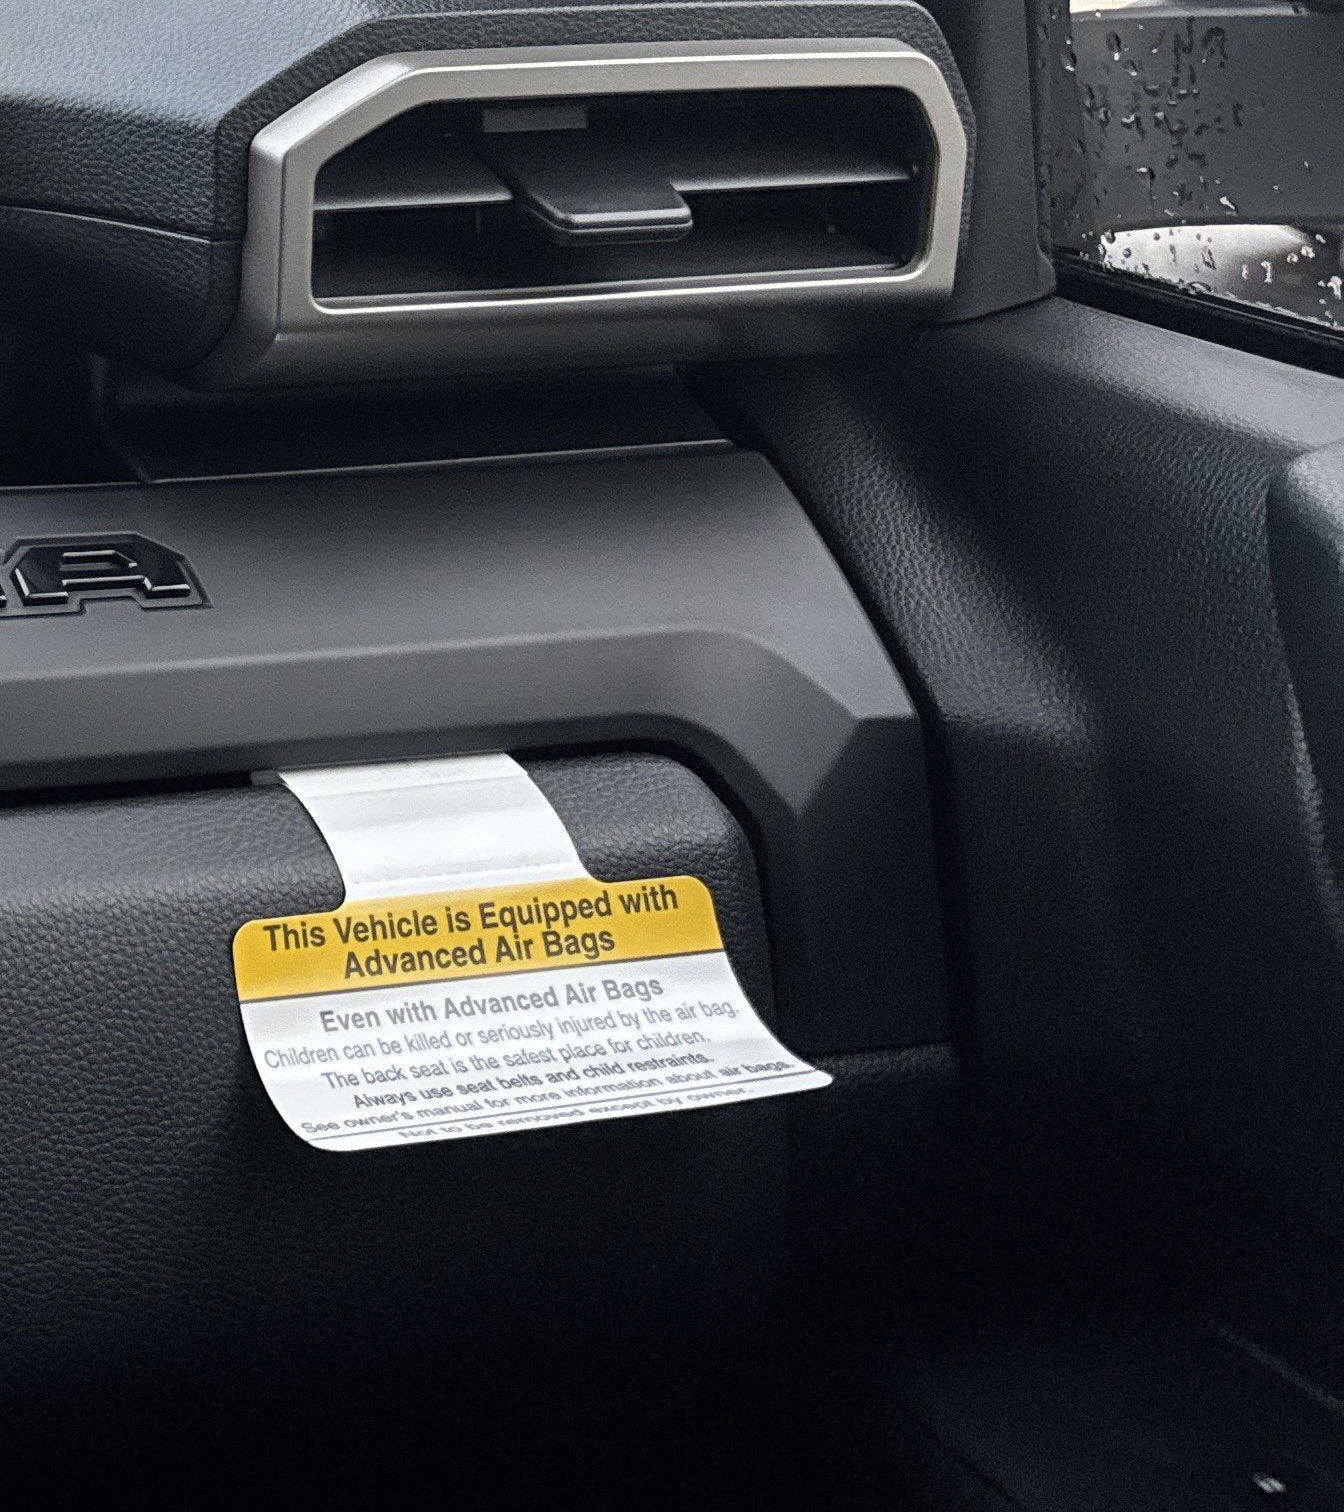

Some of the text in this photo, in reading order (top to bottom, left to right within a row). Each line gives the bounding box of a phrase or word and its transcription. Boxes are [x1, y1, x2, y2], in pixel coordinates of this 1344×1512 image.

[262, 884, 679, 951] This Vehicle is Equipped with
[344, 930, 616, 979] Advanced Air Bags
[264, 1000, 740, 1068] Children can be killed or seriously injured by the air bag.
[319, 977, 664, 1033] Even with Advanced Air Bags
[321, 1030, 711, 1089] The back seat is the safest place for children.
[353, 1050, 715, 1109] Always use seat belts and child restraints.
[300, 1121, 341, 1134] See
[343, 1110, 415, 1127] owner's
[415, 1100, 484, 1119] manual
[483, 1096, 512, 1109] for
[513, 1090, 563, 1105] more
[561, 1077, 664, 1099] information
[665, 1068, 718, 1085] about
